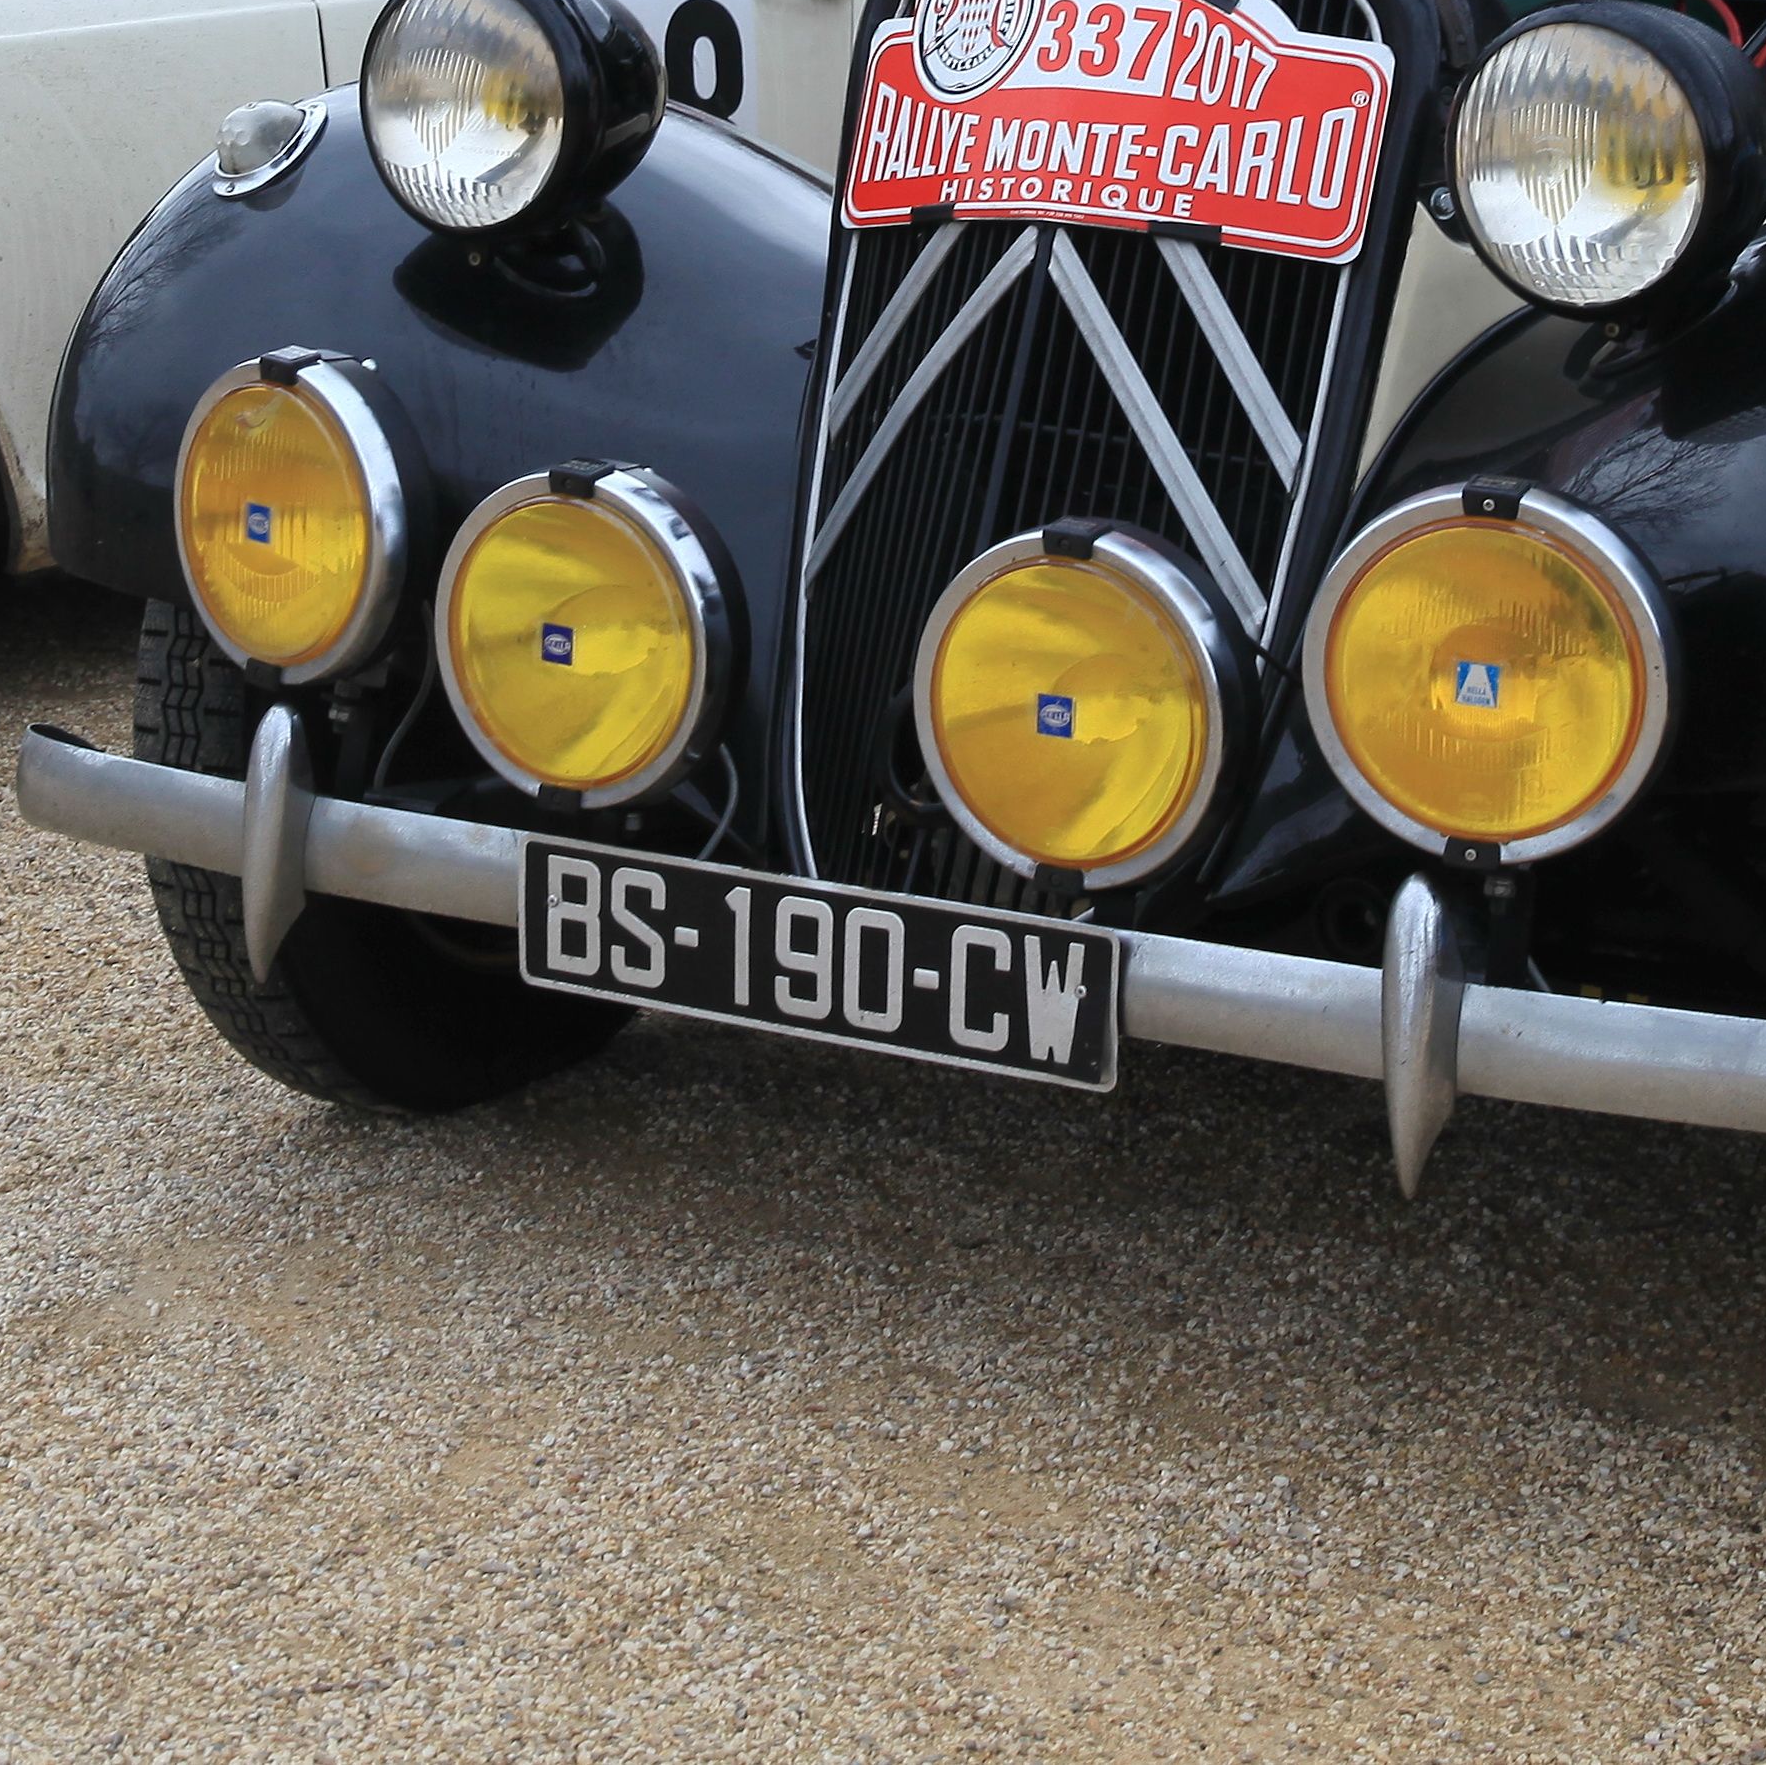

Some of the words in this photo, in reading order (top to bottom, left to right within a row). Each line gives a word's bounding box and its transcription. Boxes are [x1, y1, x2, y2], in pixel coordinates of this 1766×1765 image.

[1170, 8, 1278, 112] 2017
[861, 81, 982, 184] RALLYE
[984, 106, 1361, 211] MONTE-CARLO
[939, 176, 1196, 219] HISTORIQUE
[546, 853, 1085, 1065] BS-190-CW
